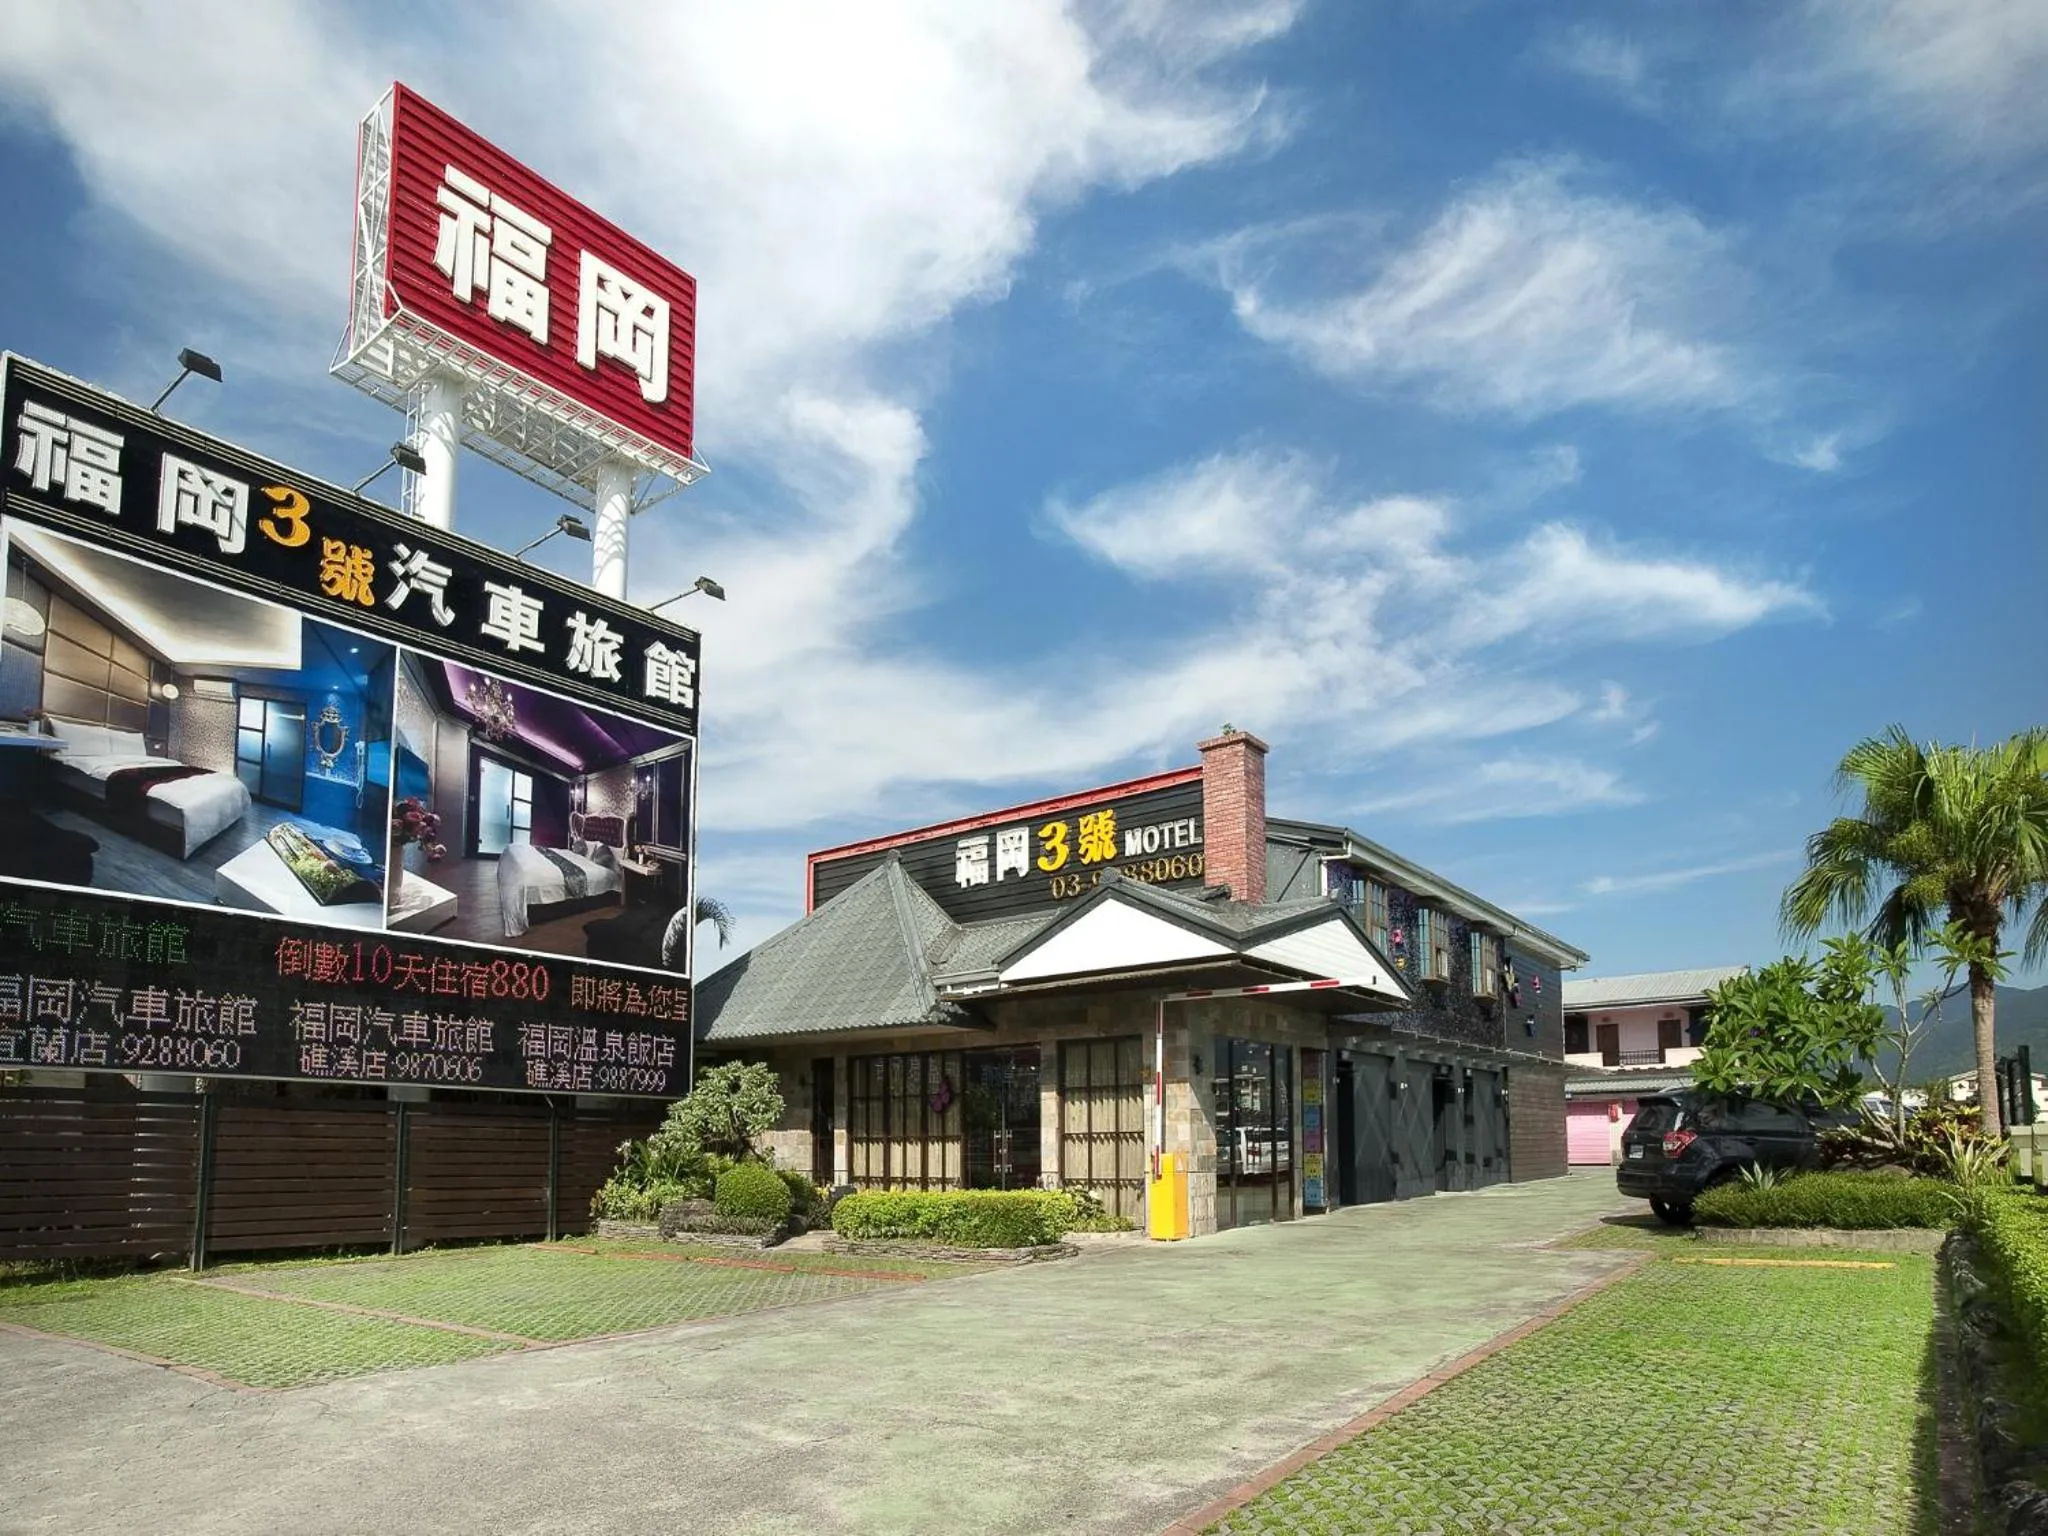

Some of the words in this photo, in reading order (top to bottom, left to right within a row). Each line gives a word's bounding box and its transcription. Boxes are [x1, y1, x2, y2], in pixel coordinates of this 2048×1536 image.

[432, 163, 671, 403] 福岡
[955, 808, 1117, 888] 福岡3號
[1124, 817, 1203, 857] MOTEL
[1050, 852, 1205, 899] 03-88060
[289, 999, 495, 1053] 福岡汽車旅館
[517, 1020, 676, 1068] 福岡溫泉飯店
